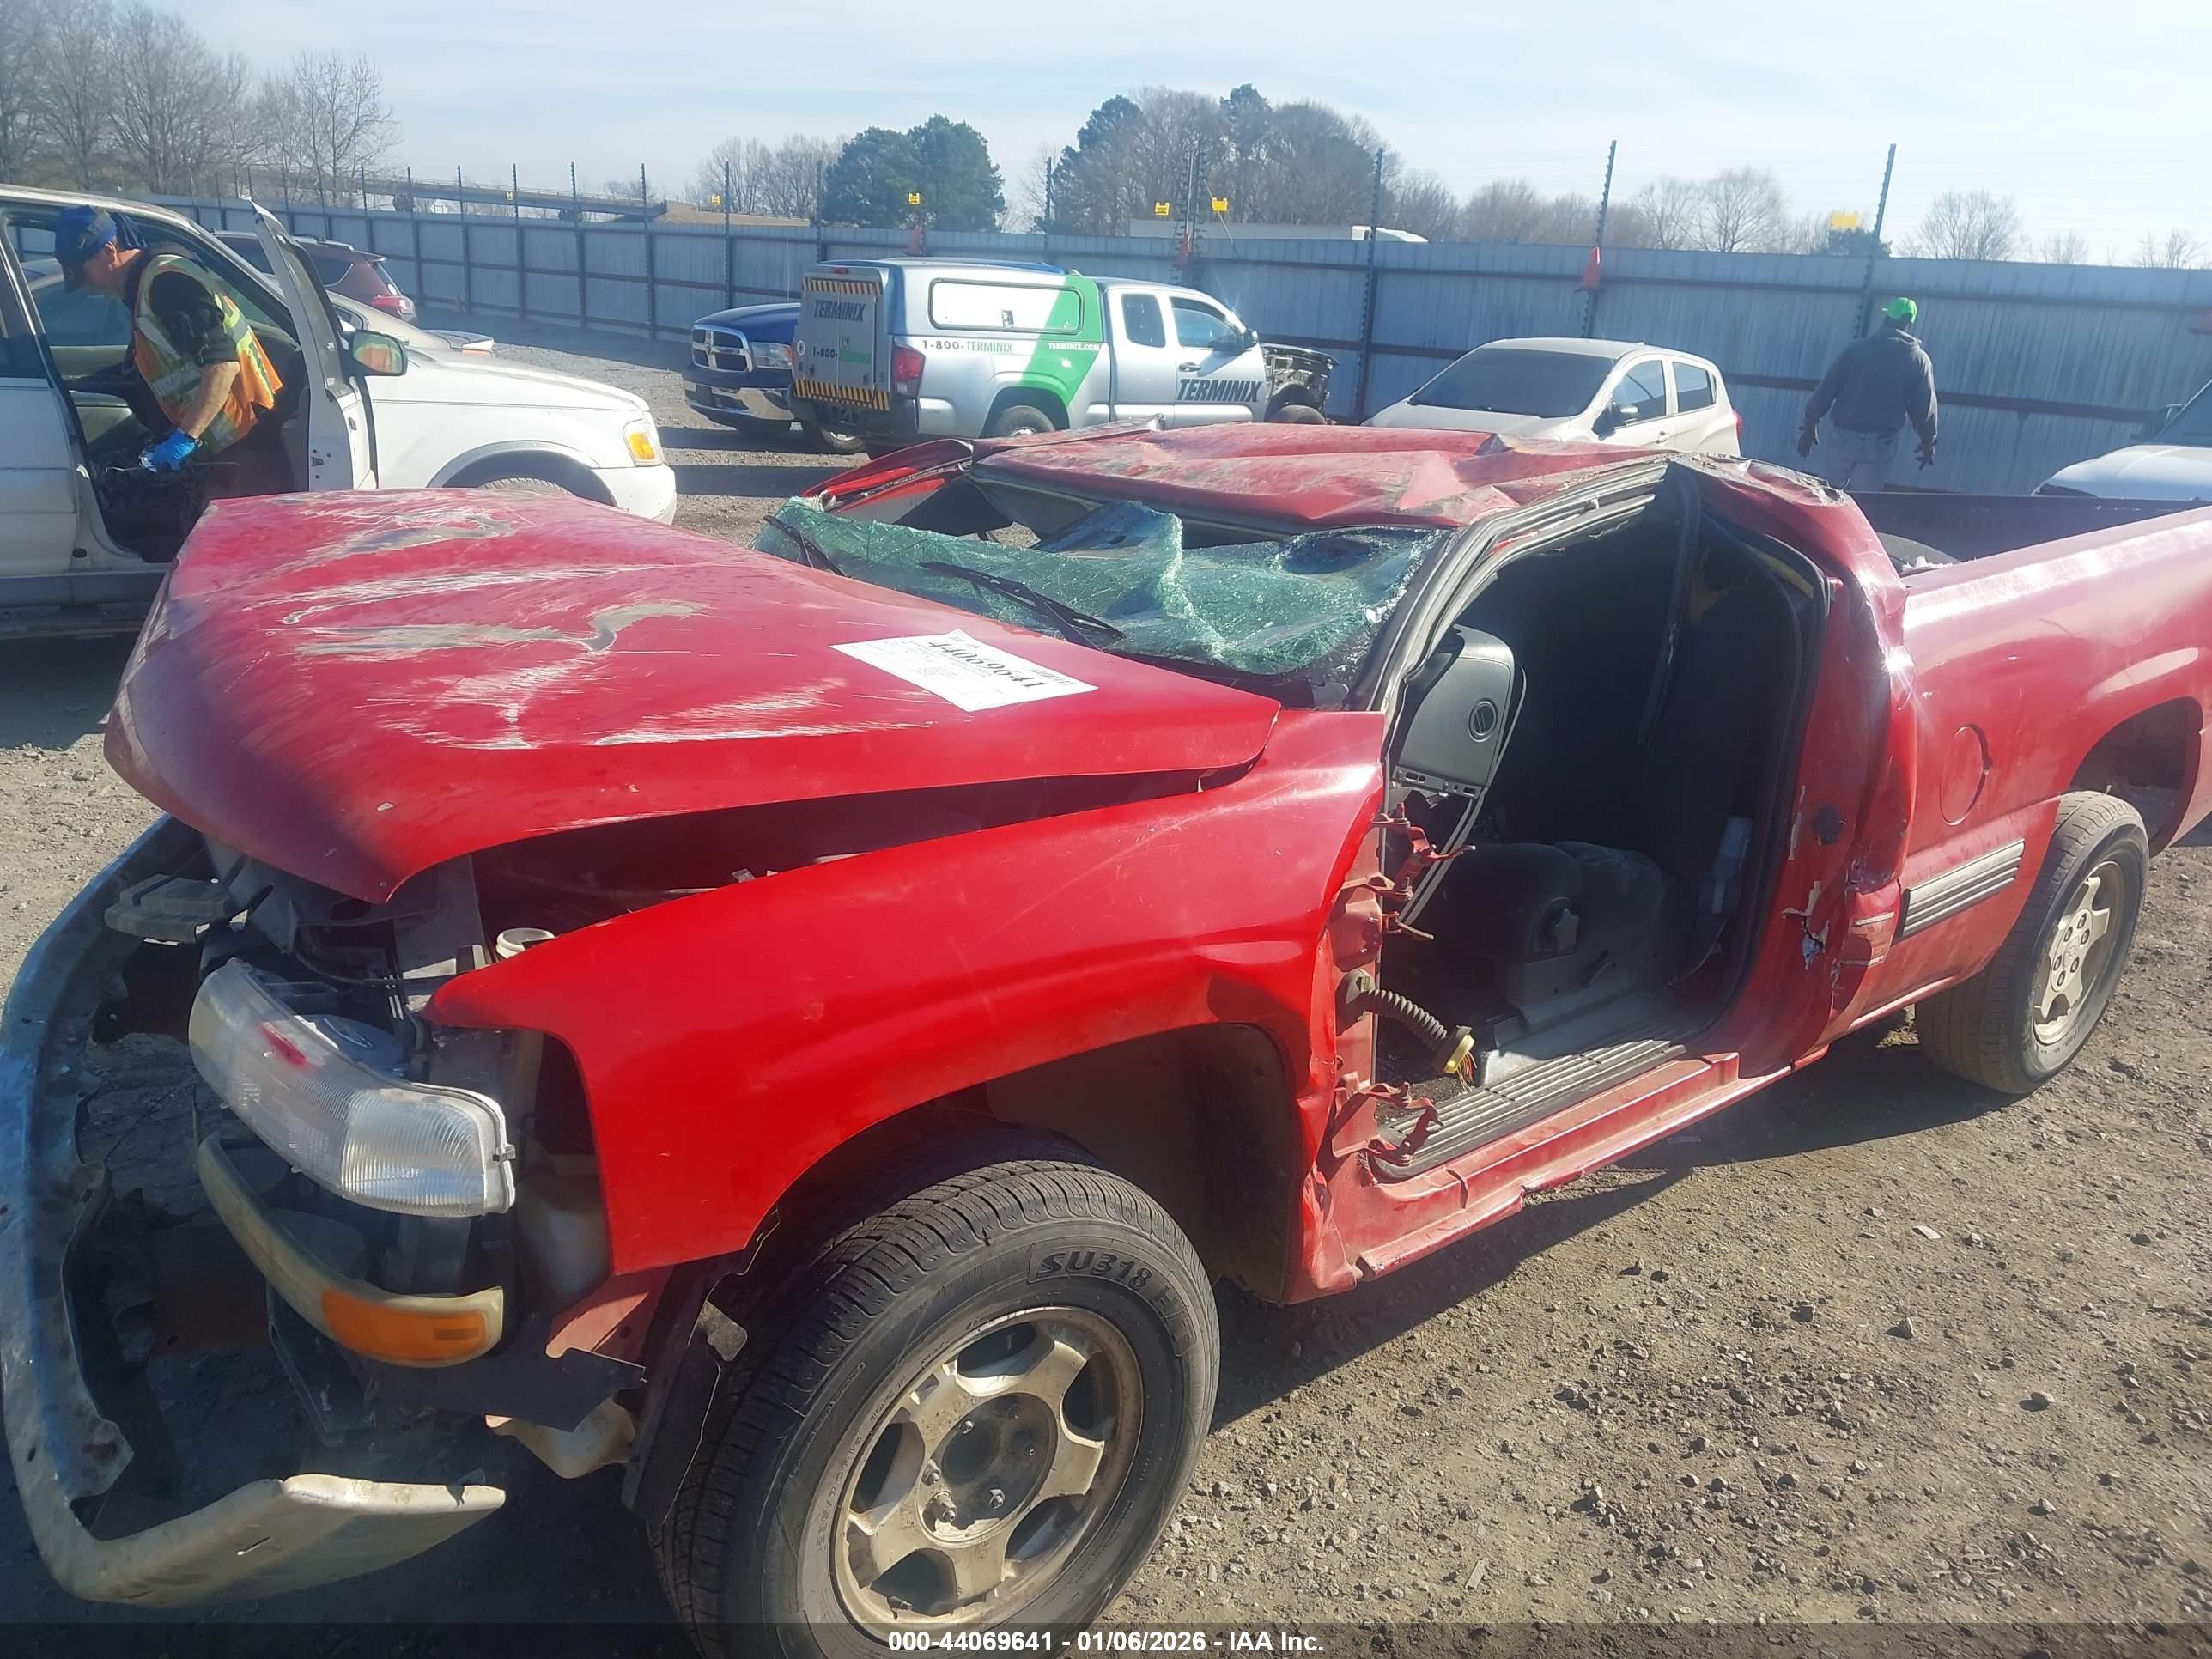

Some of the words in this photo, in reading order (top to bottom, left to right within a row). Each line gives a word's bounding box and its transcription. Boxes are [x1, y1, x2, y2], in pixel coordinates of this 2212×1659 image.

[813, 300, 866, 322] TERMINIX
[1048, 342, 1101, 352] TERMINIX.COM
[1176, 378, 1264, 403] TERMINIX
[927, 641, 1049, 688] 44069641
[1036, 1250, 1152, 1290] SU318
